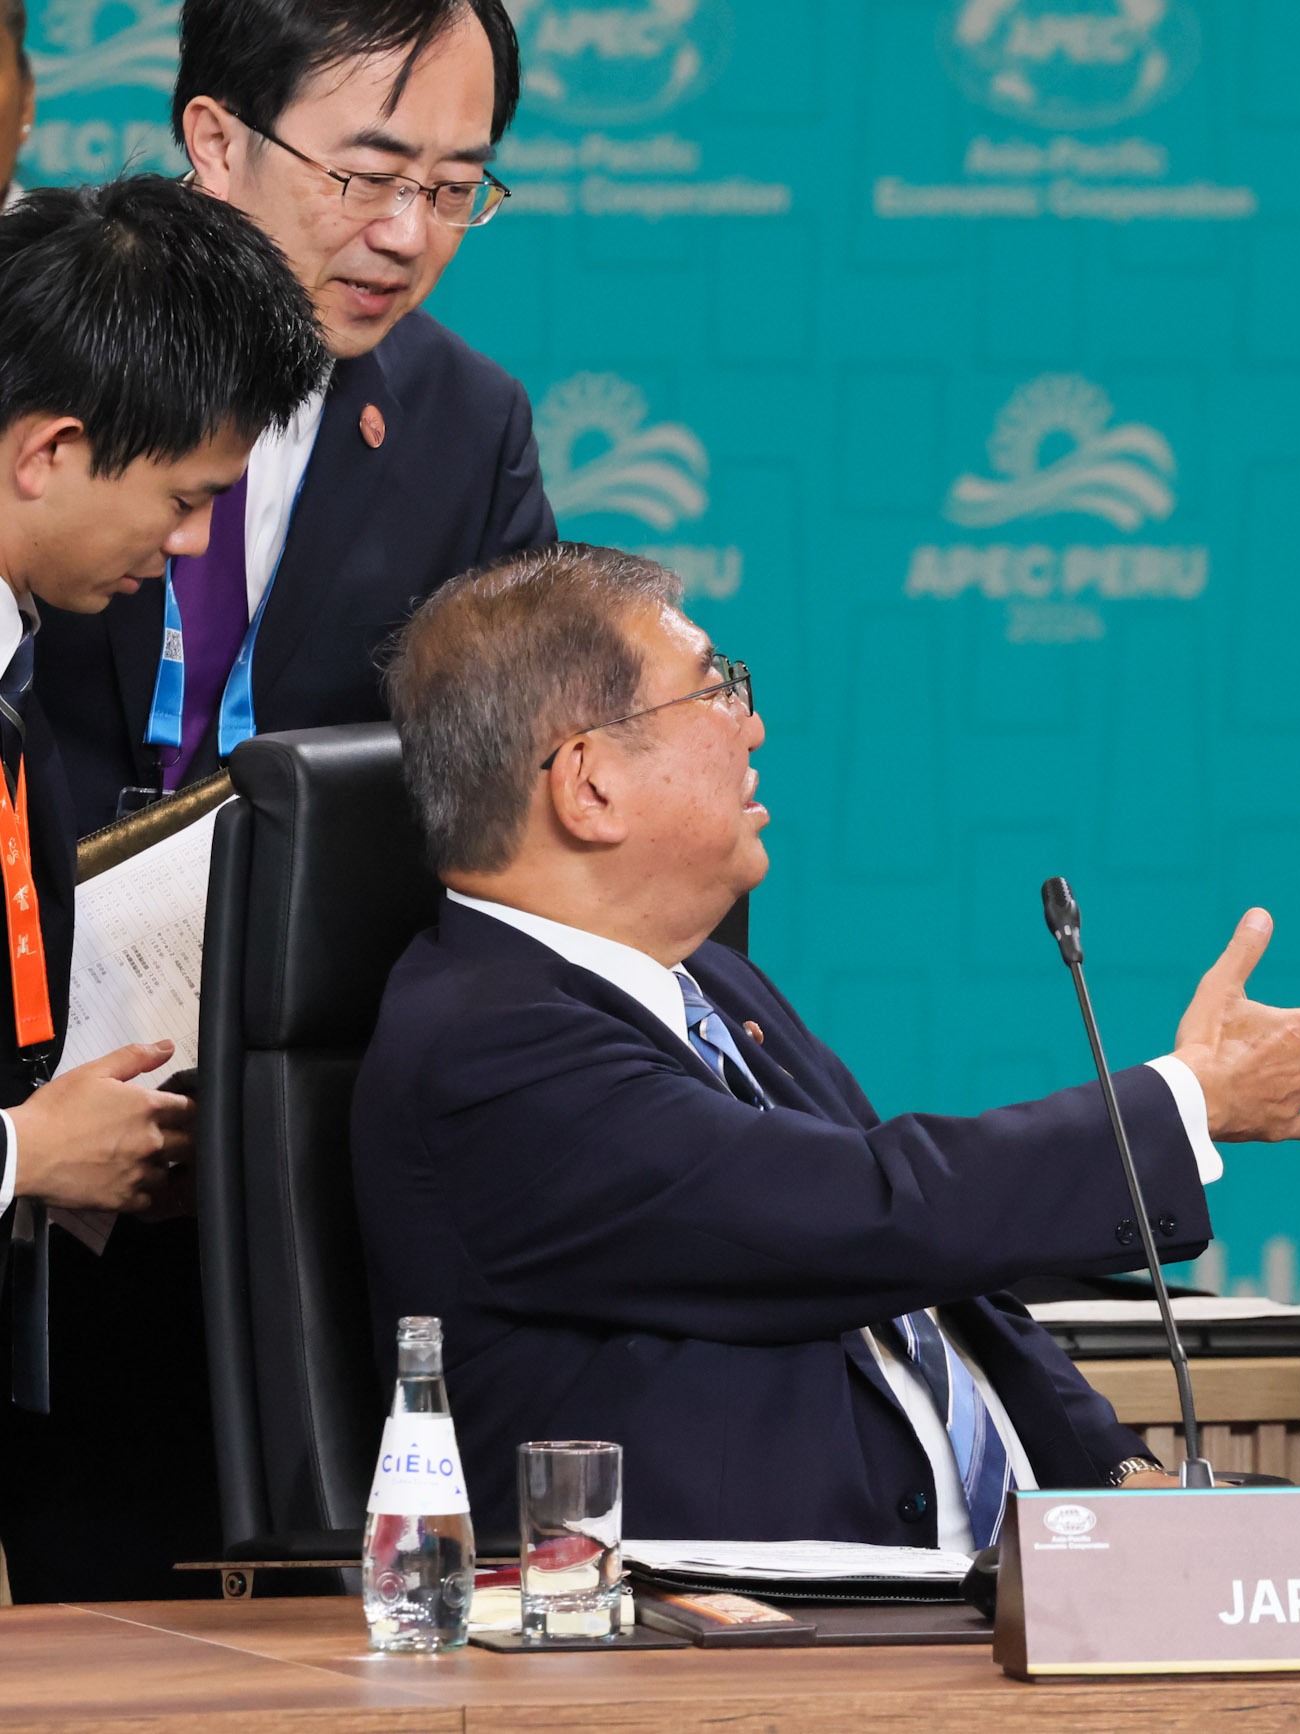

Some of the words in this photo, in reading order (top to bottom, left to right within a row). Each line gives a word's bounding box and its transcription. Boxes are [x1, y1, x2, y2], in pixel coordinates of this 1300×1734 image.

[19, 120, 114, 172] PEC
[906, 545, 1051, 599] APEC
[1062, 546, 1209, 599] PERU
